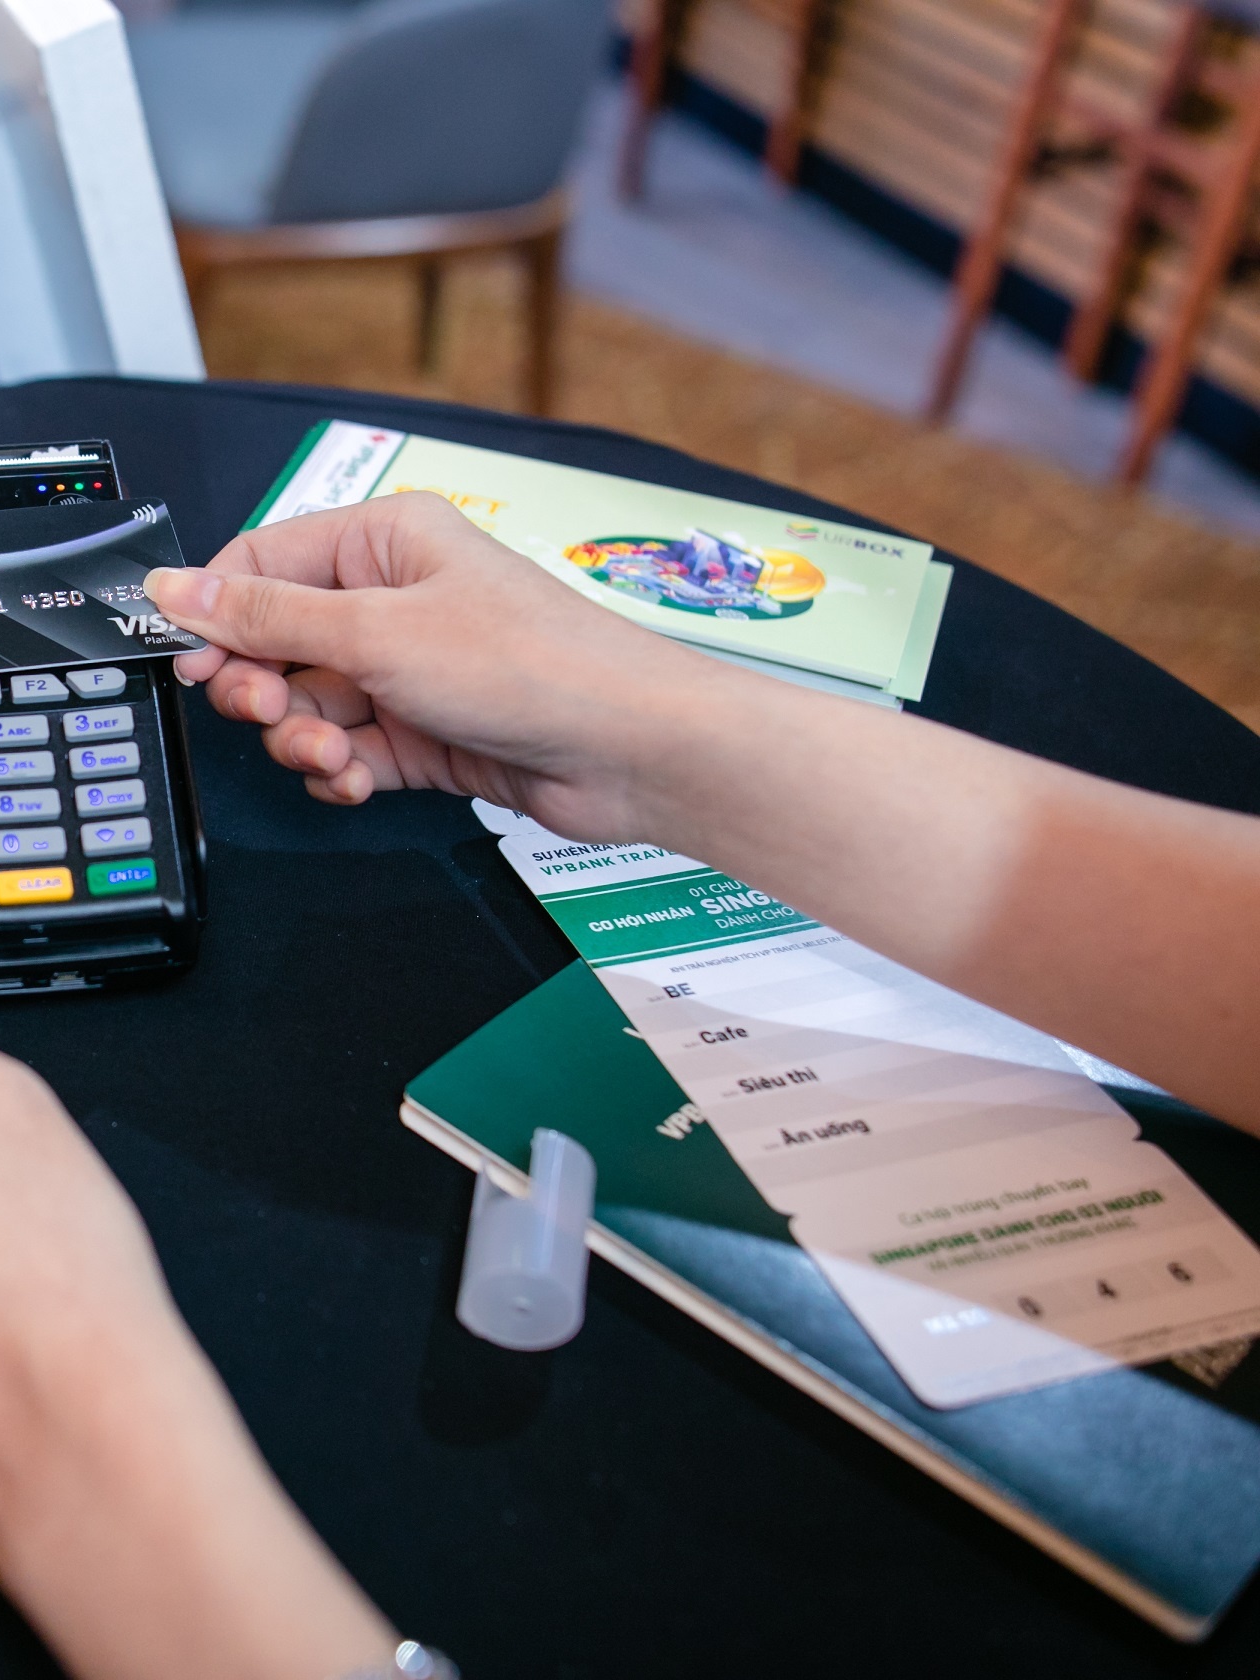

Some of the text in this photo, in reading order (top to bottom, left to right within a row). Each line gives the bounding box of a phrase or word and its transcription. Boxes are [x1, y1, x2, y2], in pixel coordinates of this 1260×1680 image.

[823, 531, 904, 559] URBOX
[21, 590, 85, 609] 4350
[107, 613, 177, 636] VIS
[144, 633, 196, 645] Platinum
[25, 680, 47, 691] F2
[94, 674, 104, 685] F
[8, 727, 32, 736] ABC
[74, 715, 119, 732] 3 DEF
[81, 751, 96, 768] 6
[0, 796, 14, 813] 8
[88, 788, 103, 806] 9
[554, 845, 591, 859] KIỆN
[539, 856, 617, 876] VPBANK
[689, 880, 749, 897] 01 CHU
[700, 890, 779, 915] SING
[613, 914, 646, 929] HỘI
[644, 906, 695, 924] NHẬN
[714, 906, 795, 929] DÀNH CHO
[760, 949, 772, 957] VP
[771, 944, 804, 955] TRAVEL
[803, 938, 828, 948] MILES
[663, 982, 696, 999] BE
[698, 1026, 749, 1045] Cafe
[737, 1072, 786, 1094] Siêu
[655, 1102, 706, 1140] VPB
